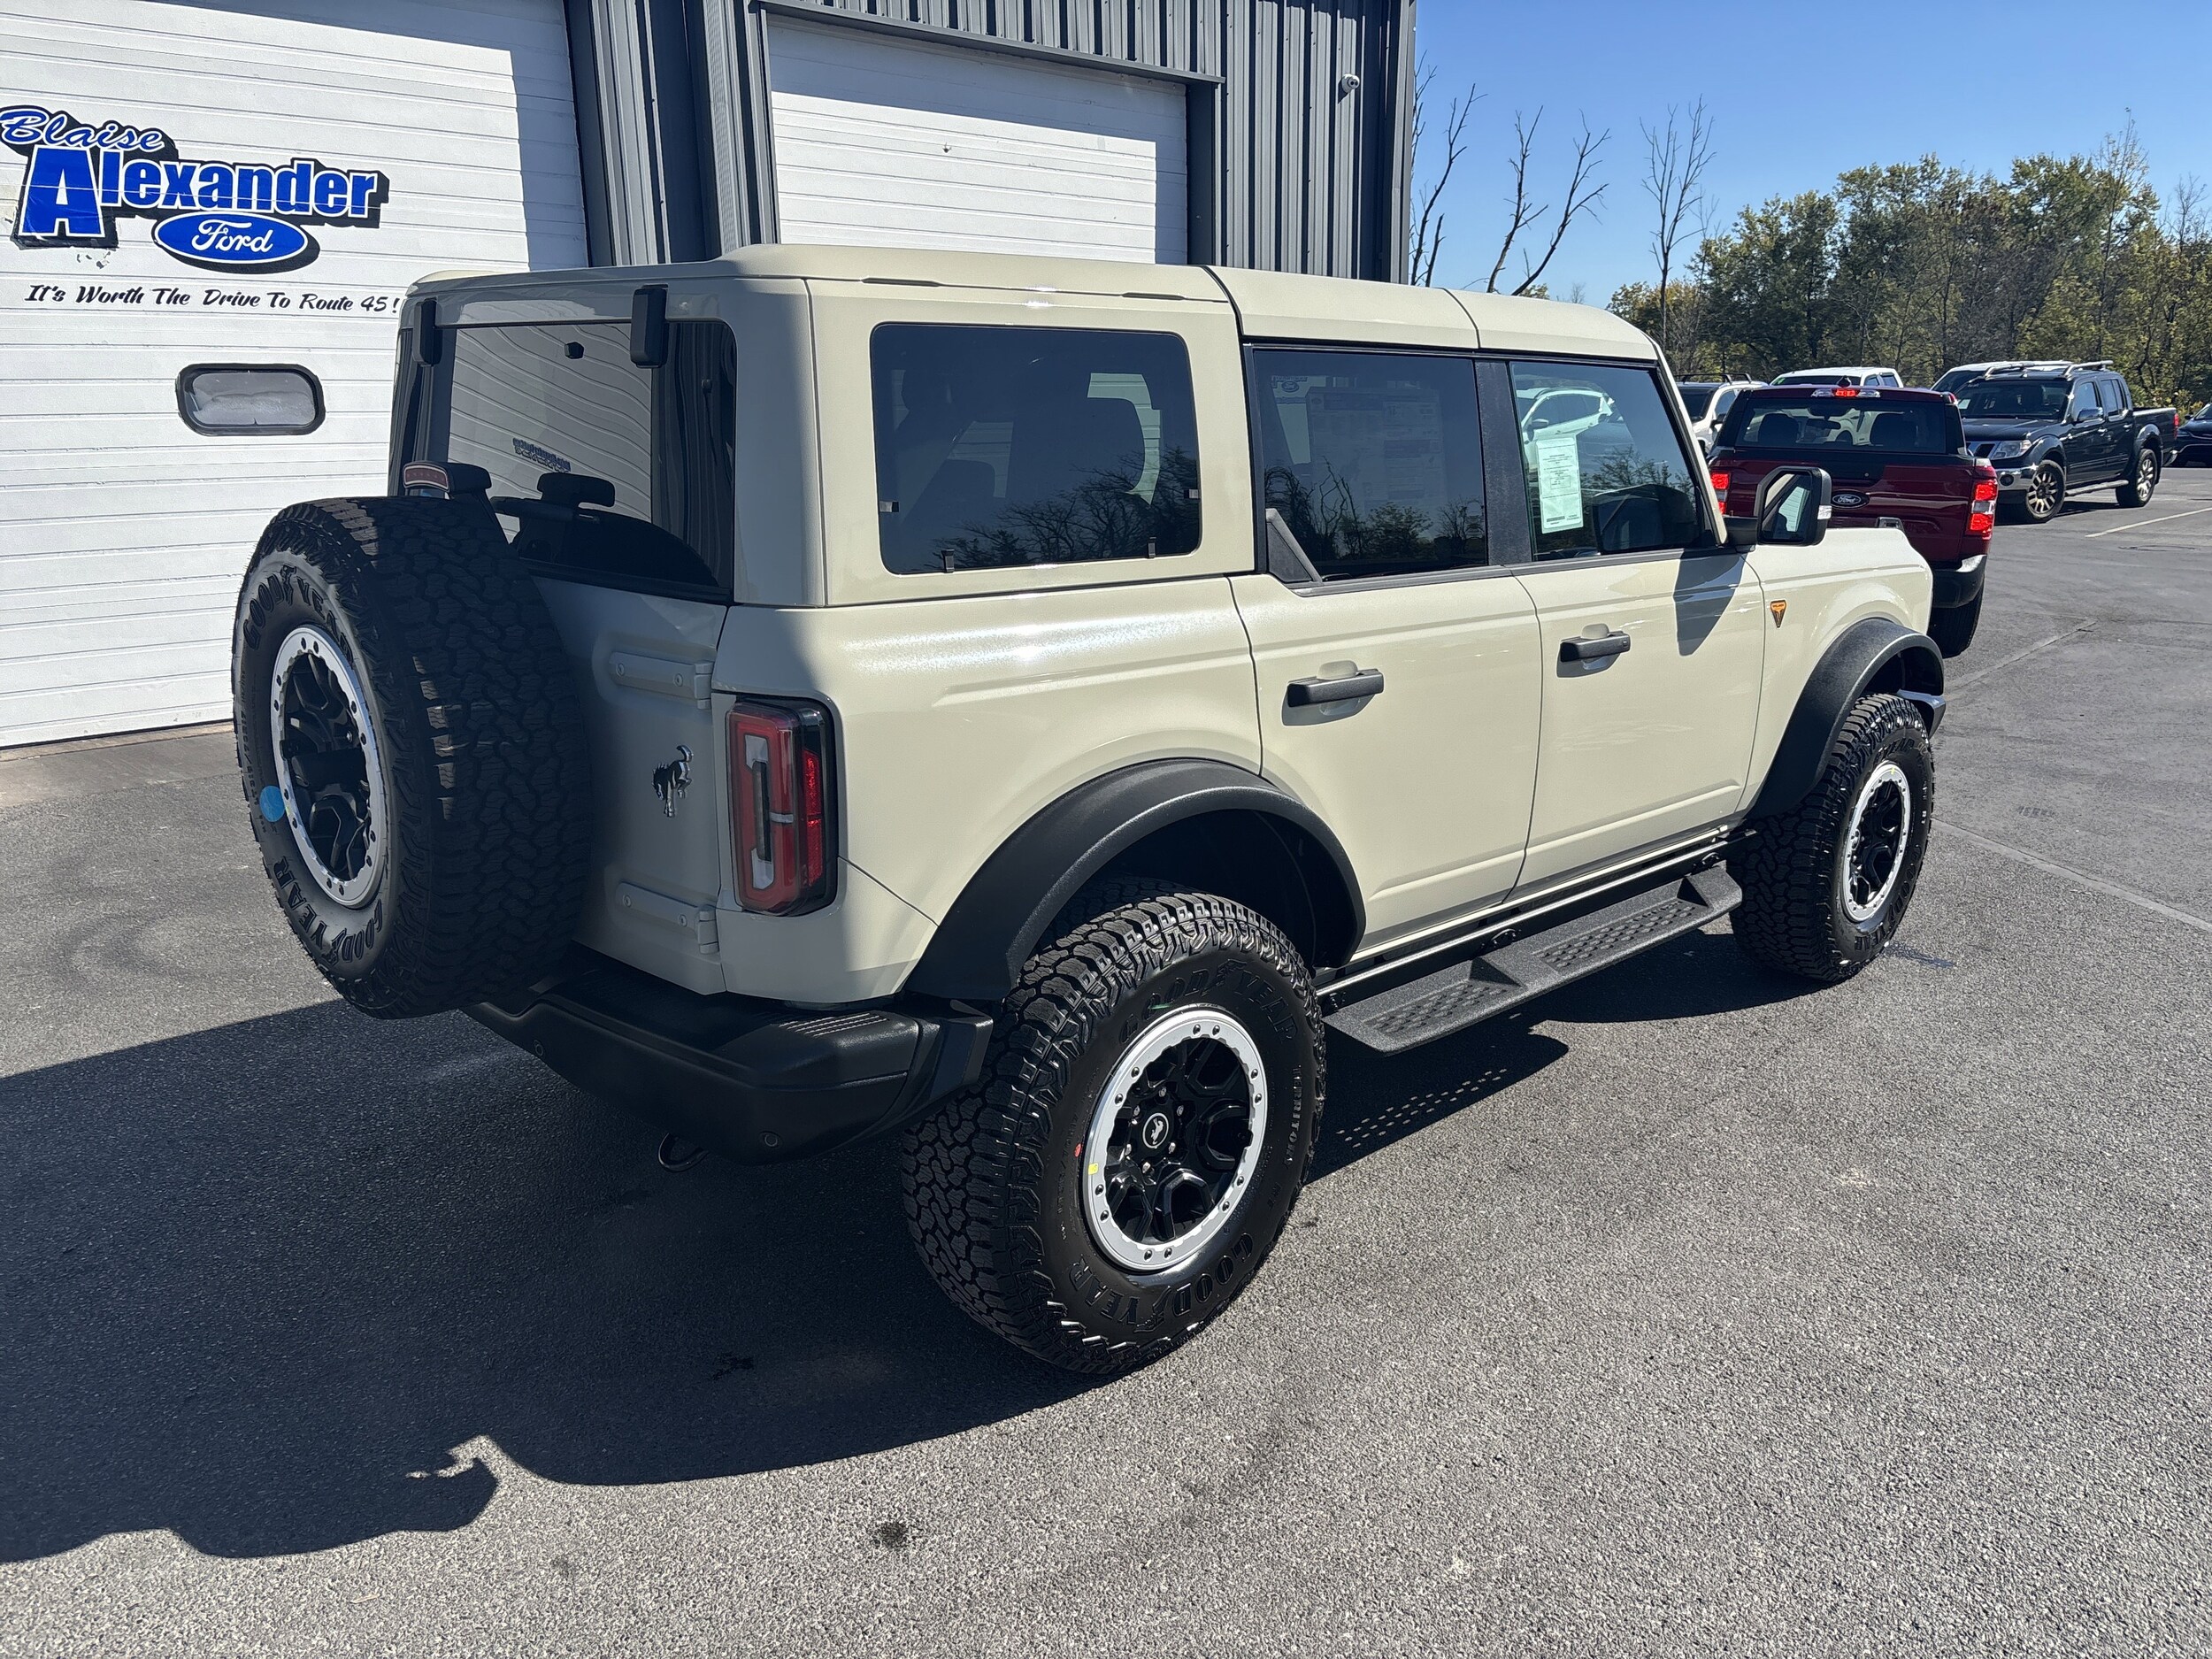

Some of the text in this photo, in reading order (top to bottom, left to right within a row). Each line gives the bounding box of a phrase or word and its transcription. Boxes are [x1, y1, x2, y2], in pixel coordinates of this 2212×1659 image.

[0, 108, 165, 152] Blaise
[18, 144, 381, 238] Alexander
[192, 218, 273, 255] Ford
[25, 284, 65, 303] It's
[76, 285, 144, 306] Worth
[152, 288, 191, 307] The
[202, 290, 260, 308] Drive
[267, 292, 290, 310] To
[299, 293, 353, 312] Route
